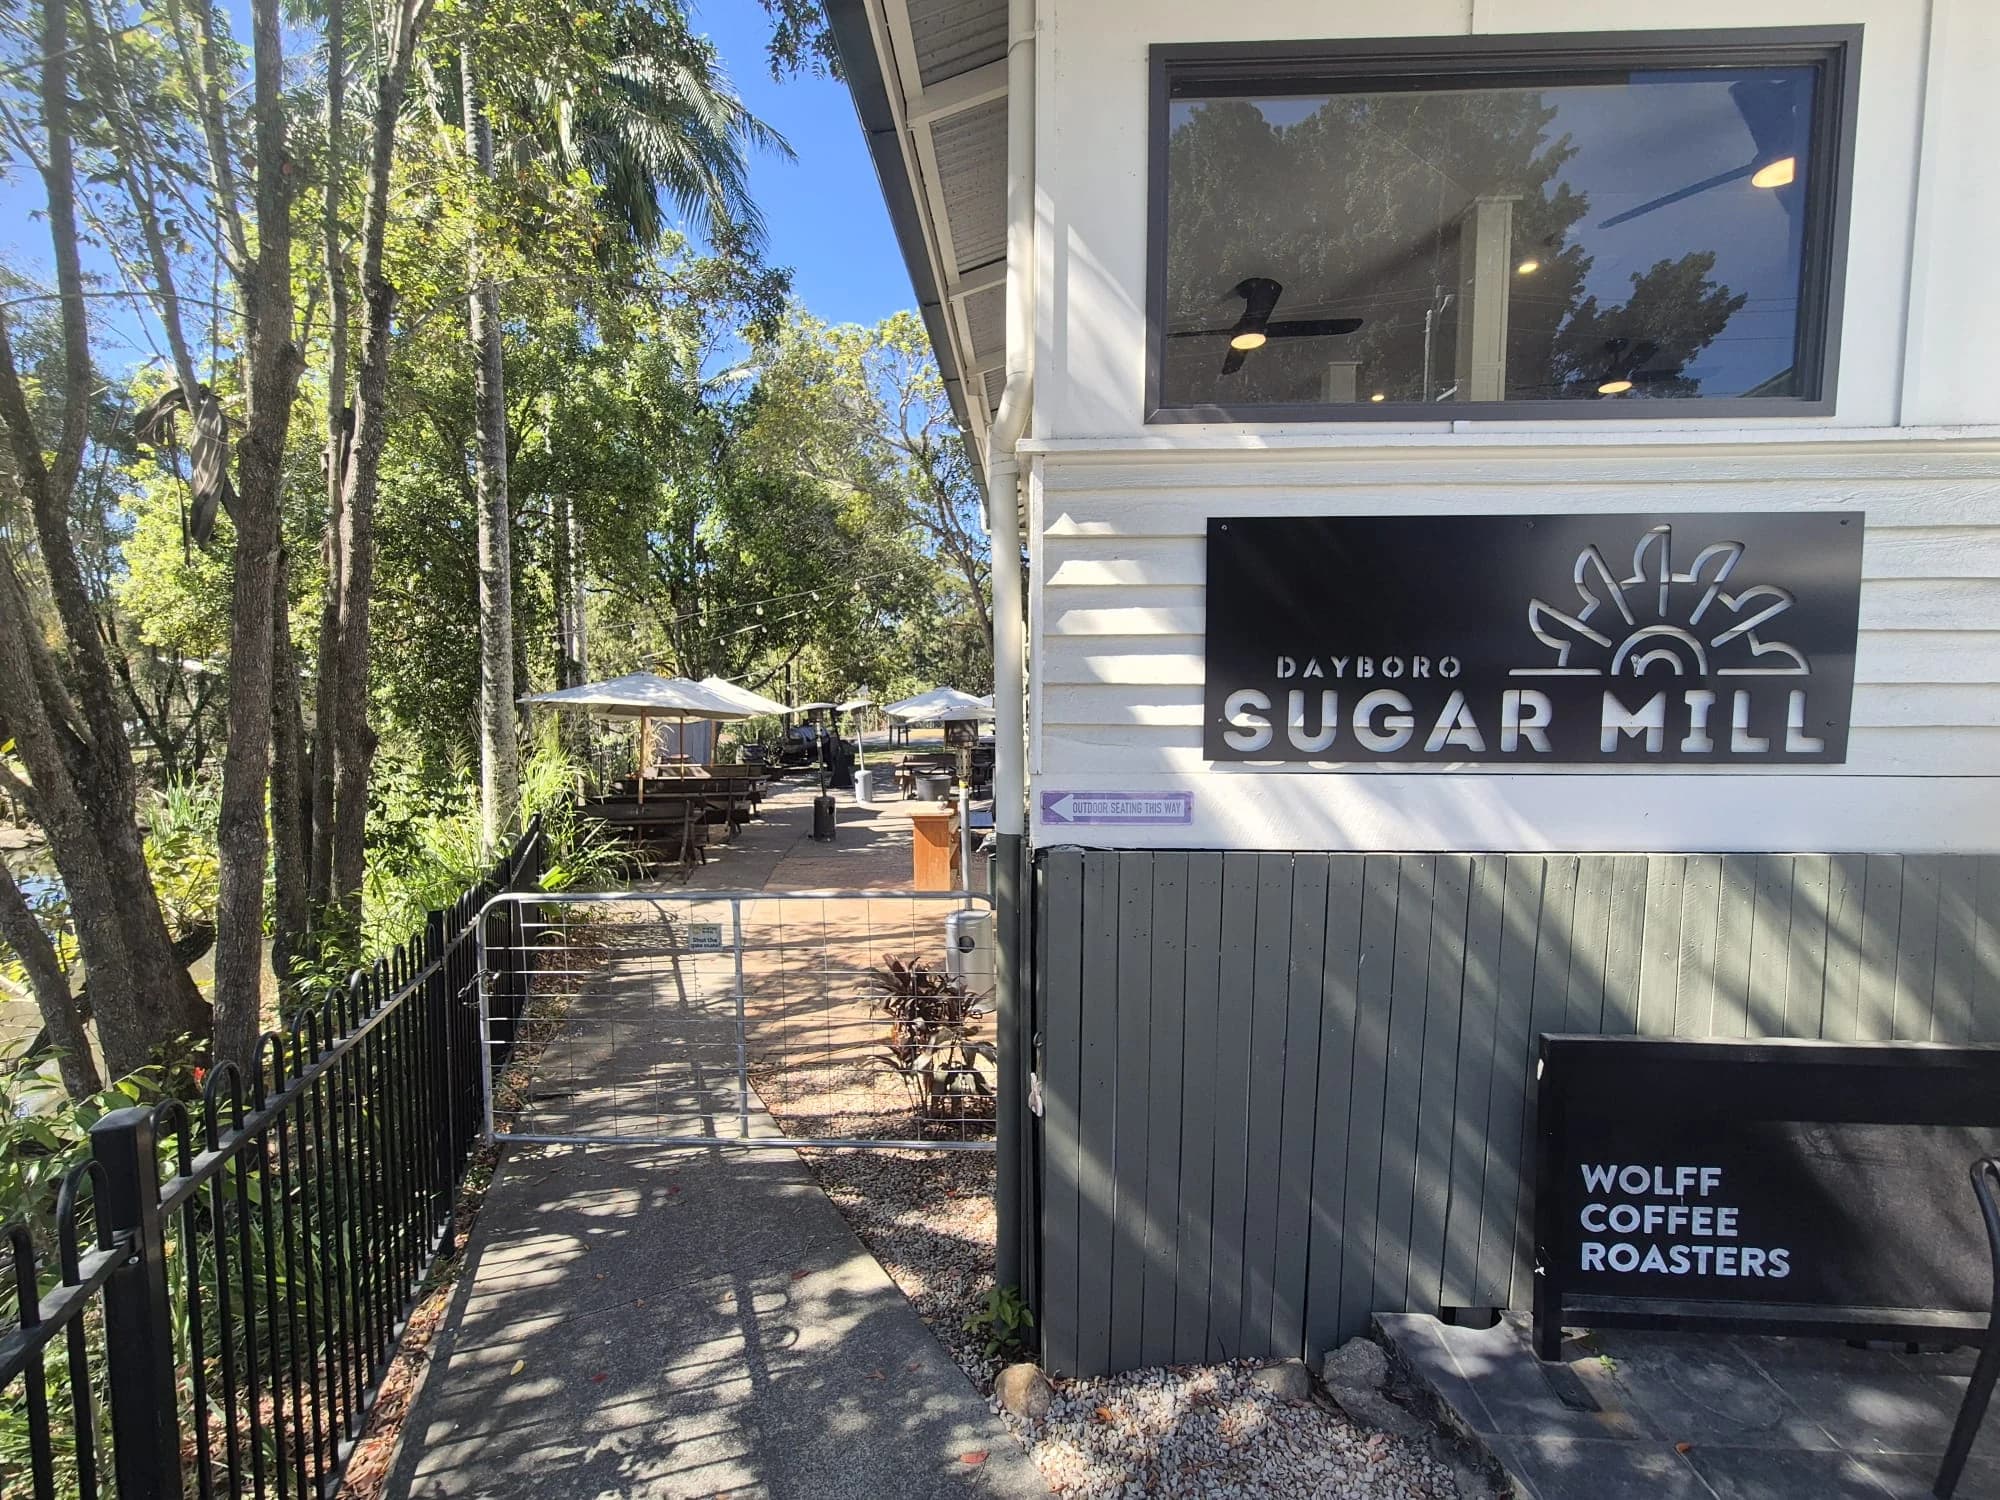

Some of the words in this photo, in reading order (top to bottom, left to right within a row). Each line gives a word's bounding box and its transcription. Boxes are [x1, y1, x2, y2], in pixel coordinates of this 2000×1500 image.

[1276, 655, 1462, 679] DAYBORO
[1222, 688, 1553, 754] SUGAR
[1600, 688, 1825, 754] MILL
[1072, 802, 1108, 814] OUTDOOR
[1110, 802, 1143, 814] SEATING
[1145, 802, 1162, 814] THIS
[1164, 802, 1181, 814] WAY
[1580, 1164, 1722, 1197] WOLFF
[1580, 1203, 1739, 1237] COFFEE
[1581, 1241, 1791, 1278] ROASTERS
